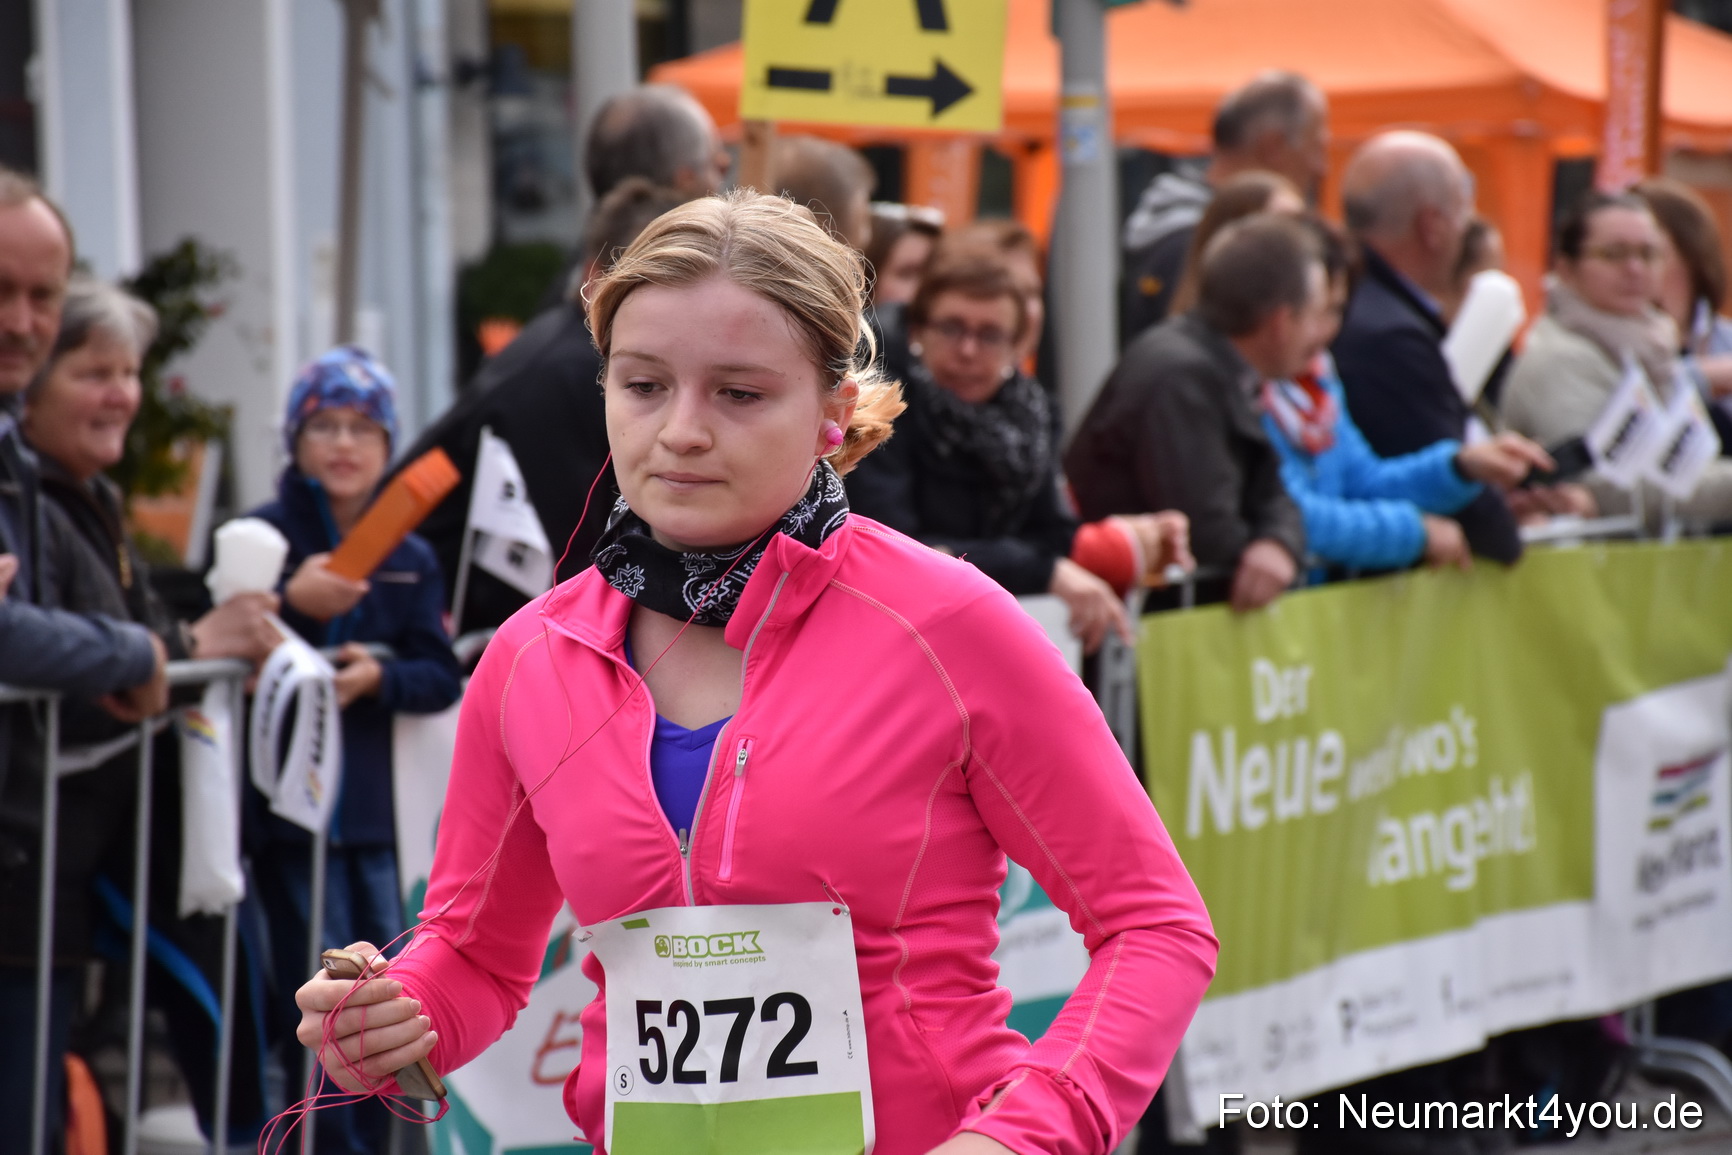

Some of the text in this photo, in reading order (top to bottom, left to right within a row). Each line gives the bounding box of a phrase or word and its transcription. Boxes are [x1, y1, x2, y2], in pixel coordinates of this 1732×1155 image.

[1252, 655, 1314, 724] Der
[1185, 726, 1346, 840] Neue
[672, 931, 764, 959] BOCK
[673, 955, 766, 968] inspired by smart concepts
[636, 992, 819, 1085] 5272
[620, 1073, 627, 1089] S
